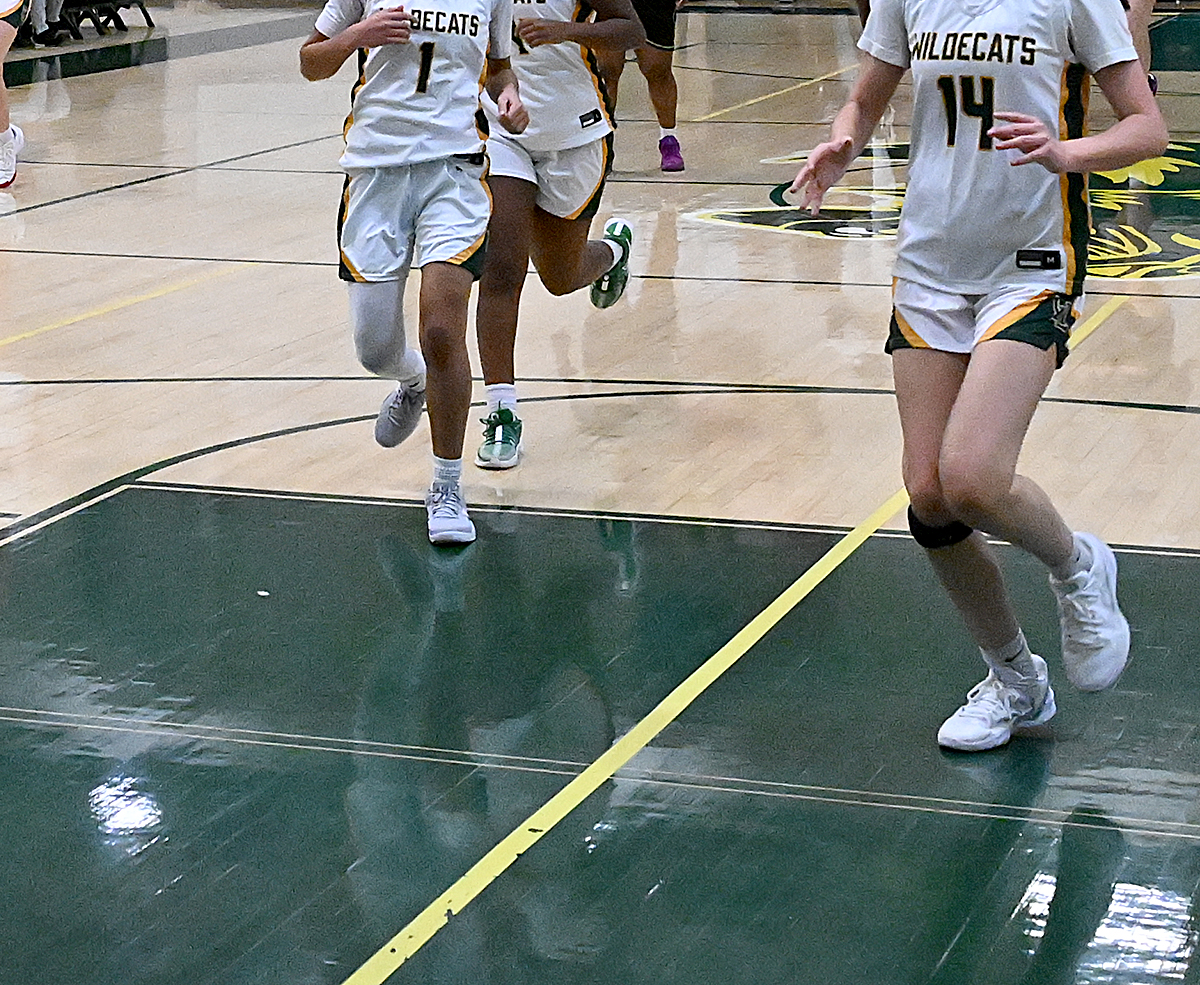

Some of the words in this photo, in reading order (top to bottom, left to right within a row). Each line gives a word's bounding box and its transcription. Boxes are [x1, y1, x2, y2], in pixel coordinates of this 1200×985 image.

[410, 9, 480, 37] DECATS
[418, 41, 436, 94] 1
[911, 32, 1036, 66] WILDECATS
[937, 75, 996, 151] 14
